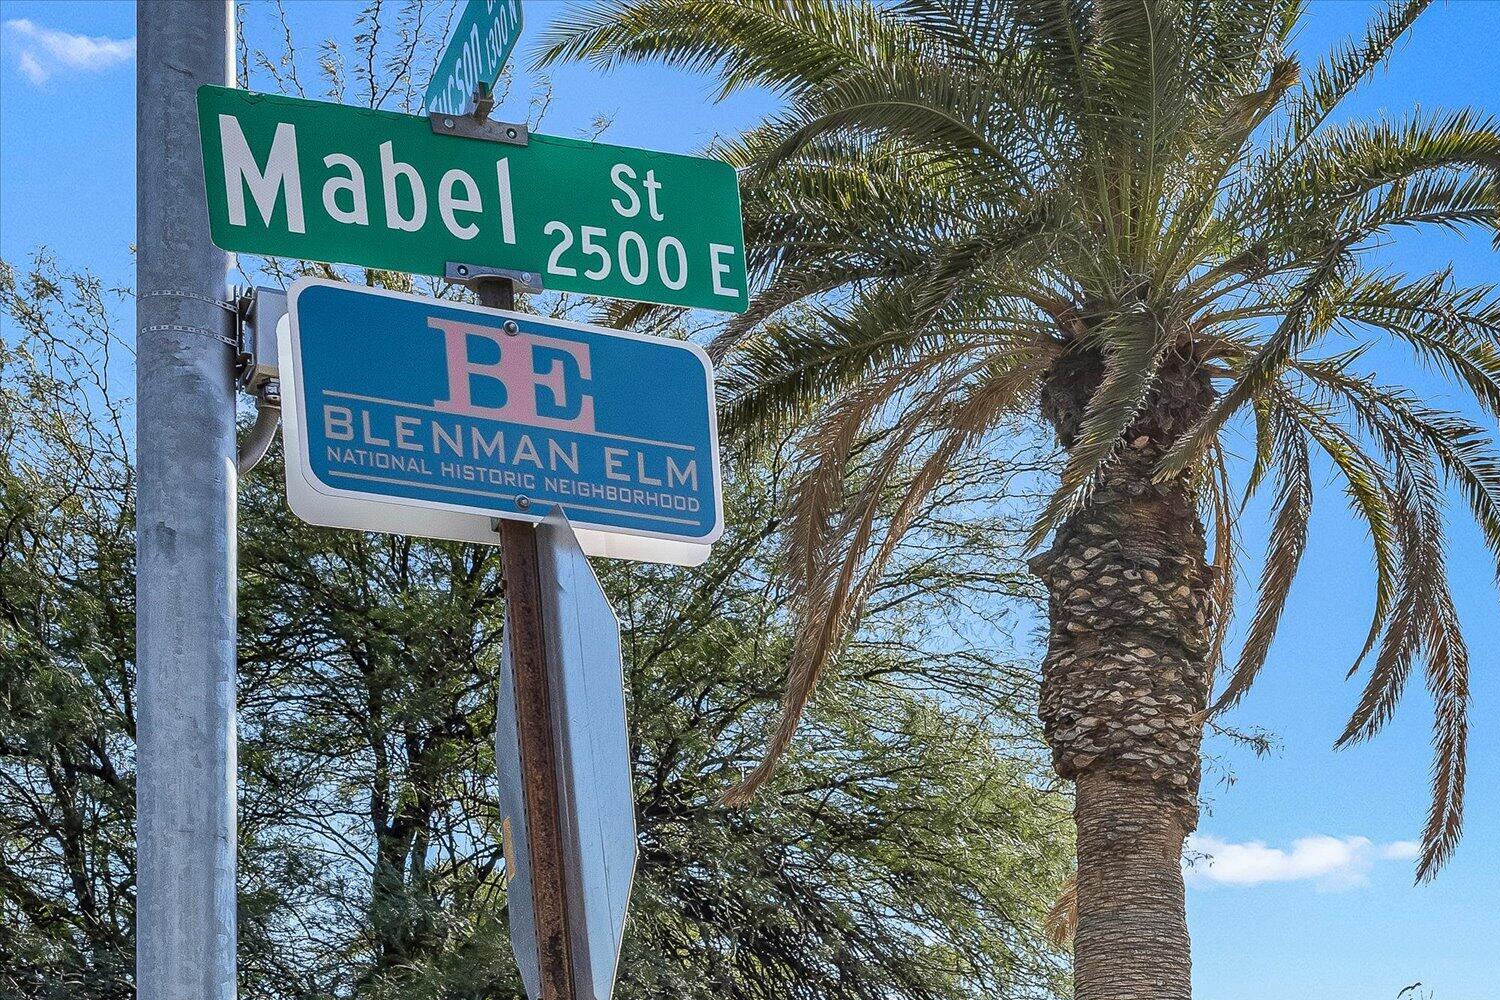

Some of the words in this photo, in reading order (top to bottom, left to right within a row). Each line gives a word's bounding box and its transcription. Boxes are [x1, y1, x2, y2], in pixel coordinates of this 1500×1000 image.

[485, 4, 508, 75] 1300
[218, 114, 517, 245] Mabel
[609, 163, 664, 222] St
[543, 220, 688, 291] 2500
[709, 244, 740, 298] E
[427, 316, 596, 432] BE
[323, 404, 580, 475] BLENMAN
[604, 447, 699, 492] ELM
[326, 446, 432, 475] NATIONAL
[441, 462, 536, 490] HISTORIC
[544, 477, 700, 513] NEIGHBORHOOD
